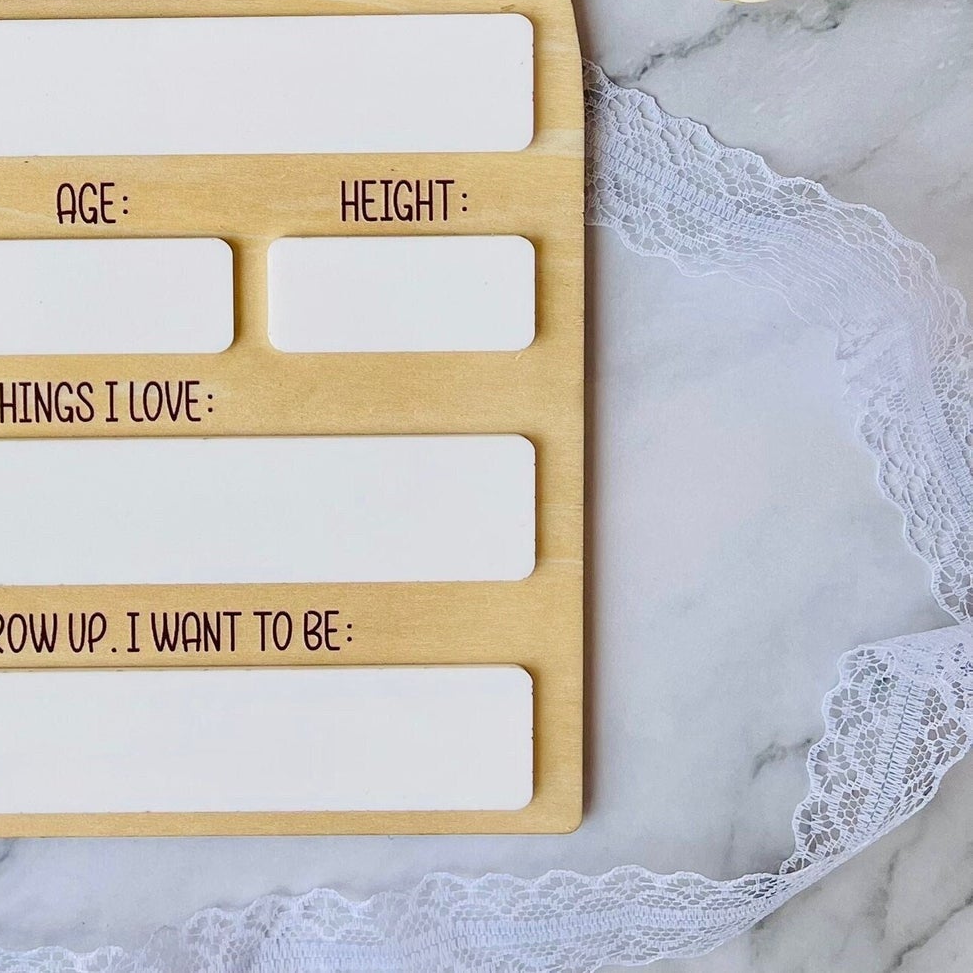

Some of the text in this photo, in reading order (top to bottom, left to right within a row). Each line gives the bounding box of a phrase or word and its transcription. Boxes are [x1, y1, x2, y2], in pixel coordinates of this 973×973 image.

[56, 182, 129, 225] AGE:
[341, 179, 468, 222] HEIGHT:
[104, 380, 119, 423] I
[129, 380, 214, 423] LOVE:
[126, 611, 141, 653] I
[150, 611, 243, 653] WANT
[252, 610, 293, 652] TO
[303, 610, 354, 651] BE:
